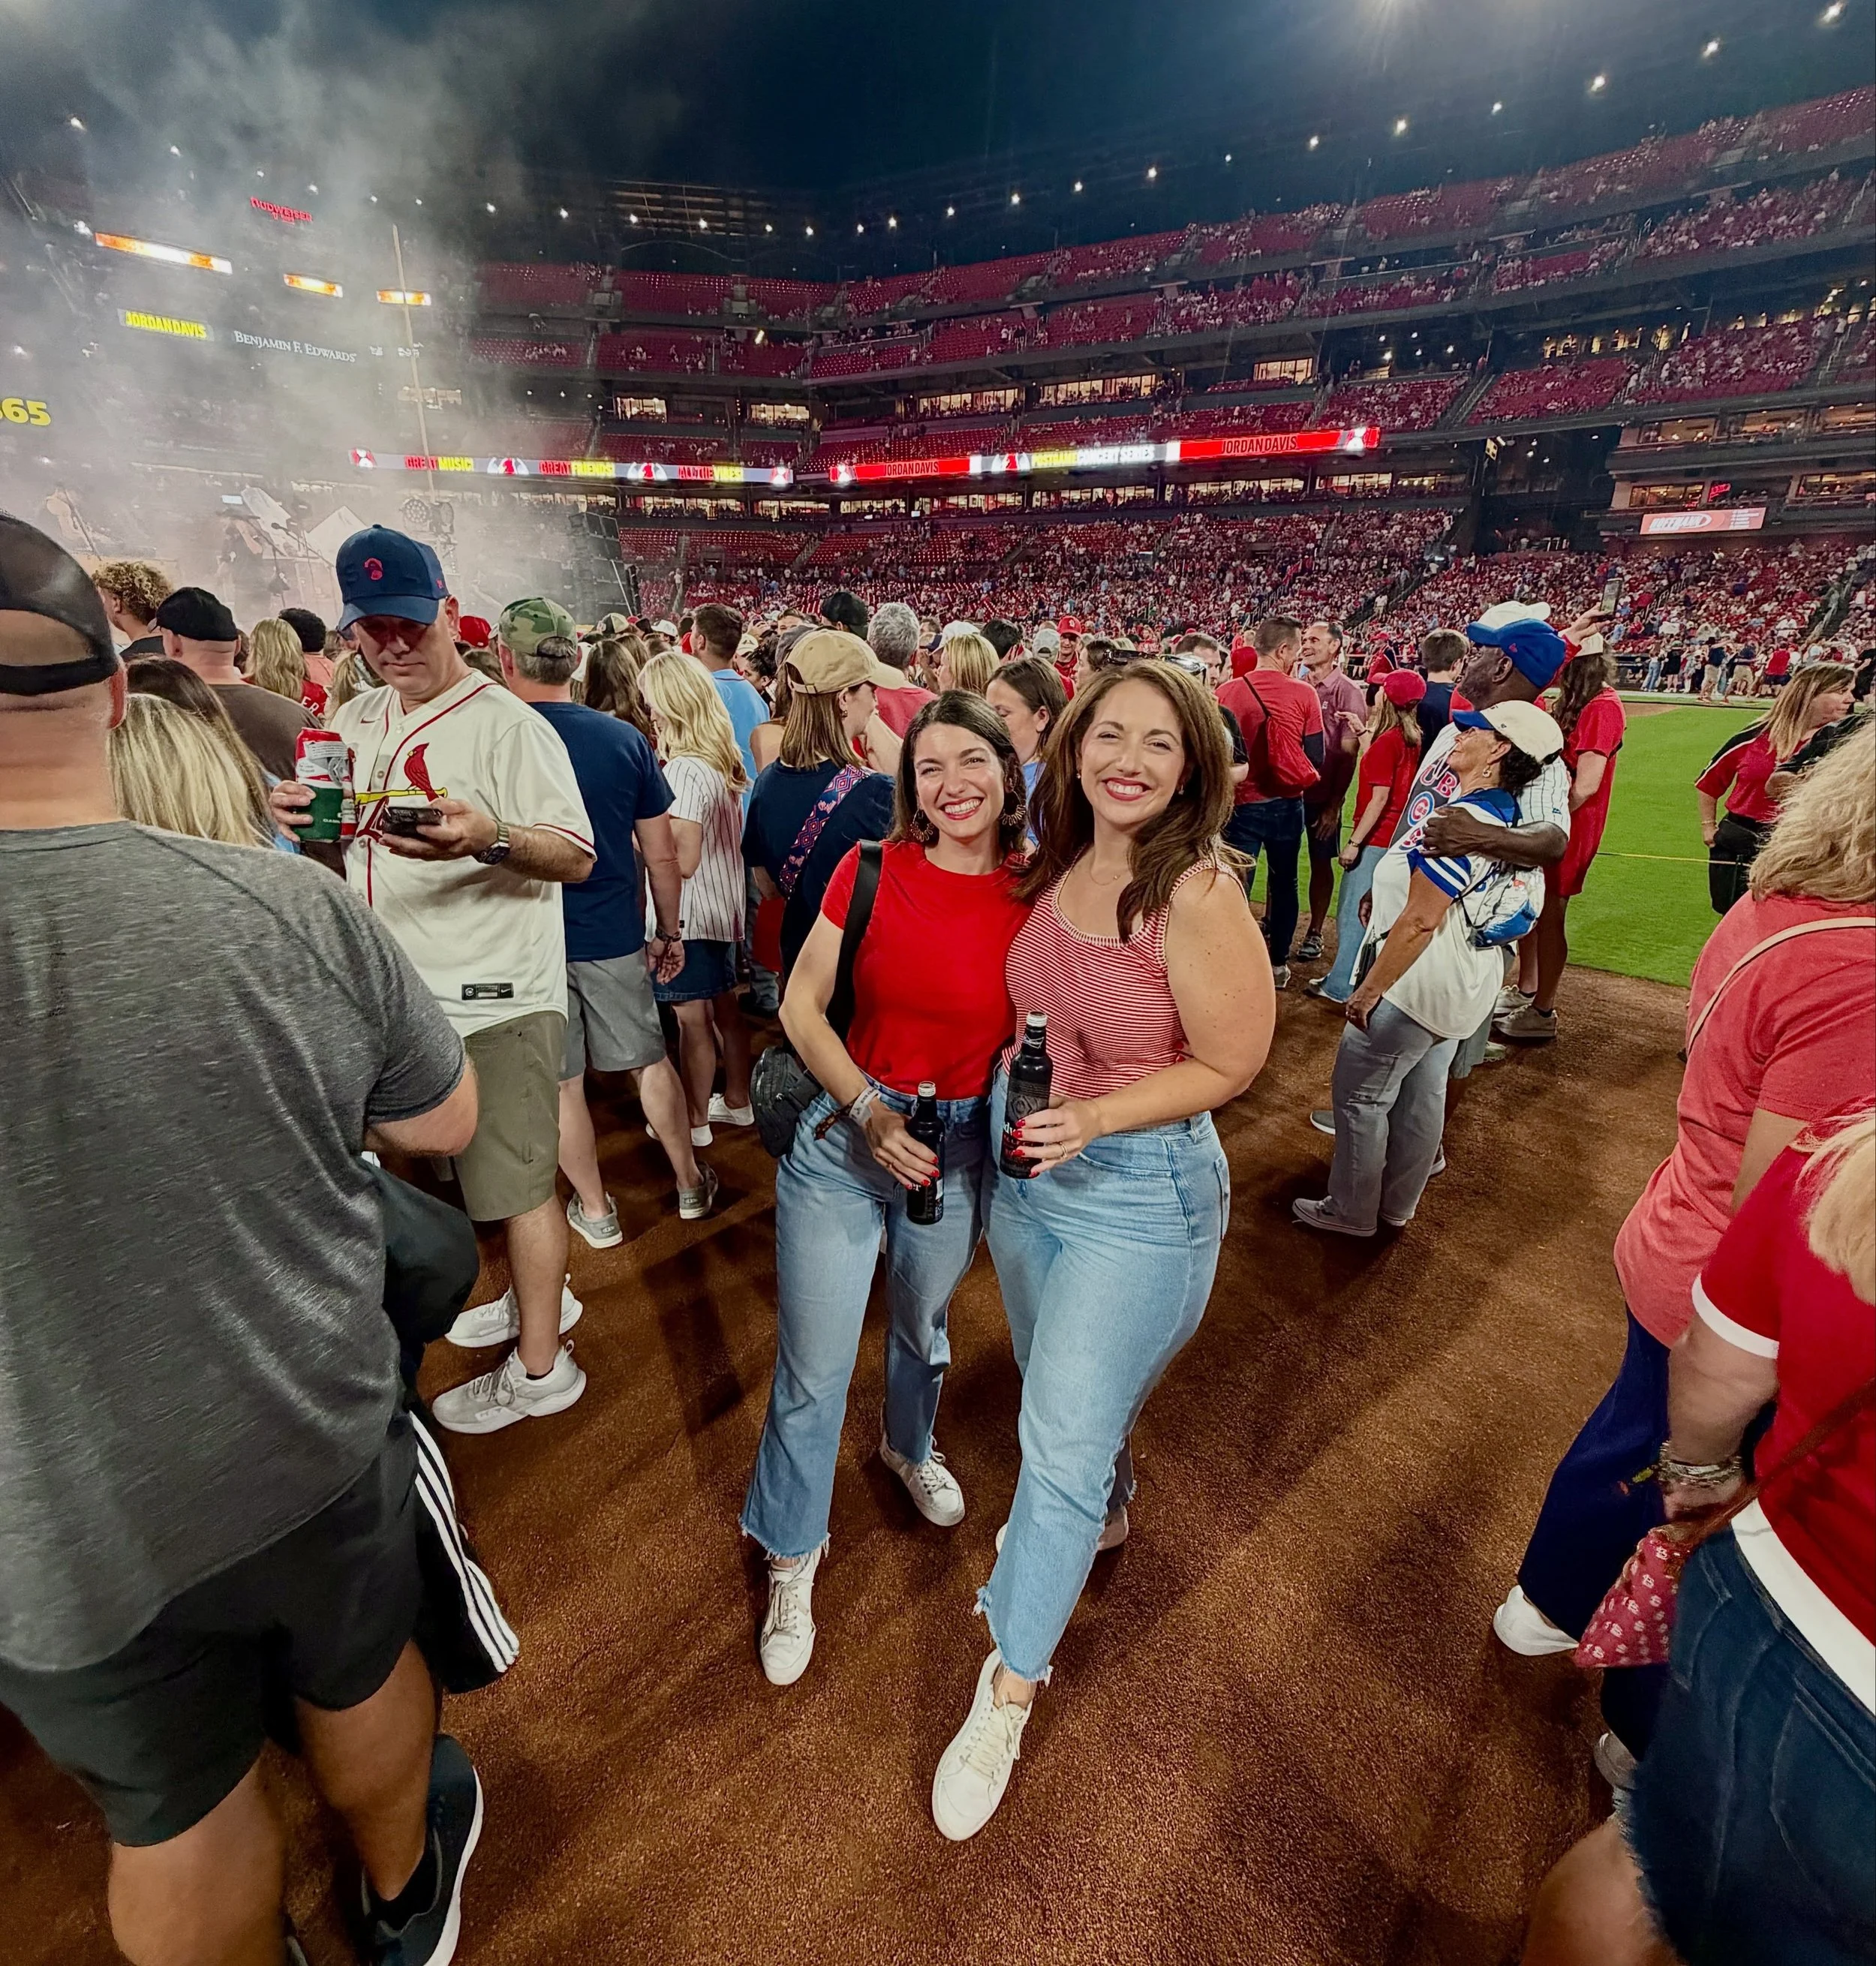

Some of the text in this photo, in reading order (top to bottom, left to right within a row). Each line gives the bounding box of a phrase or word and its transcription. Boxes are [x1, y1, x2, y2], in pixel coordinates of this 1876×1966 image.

[233, 330, 357, 362] BENJAMIN F. EDWARDS
[0, 398, 51, 426] 65
[1222, 435, 1297, 454] JORDAN DAVIS
[540, 460, 571, 476] GREAT
[885, 461, 938, 476] JORDAN DAVIS
